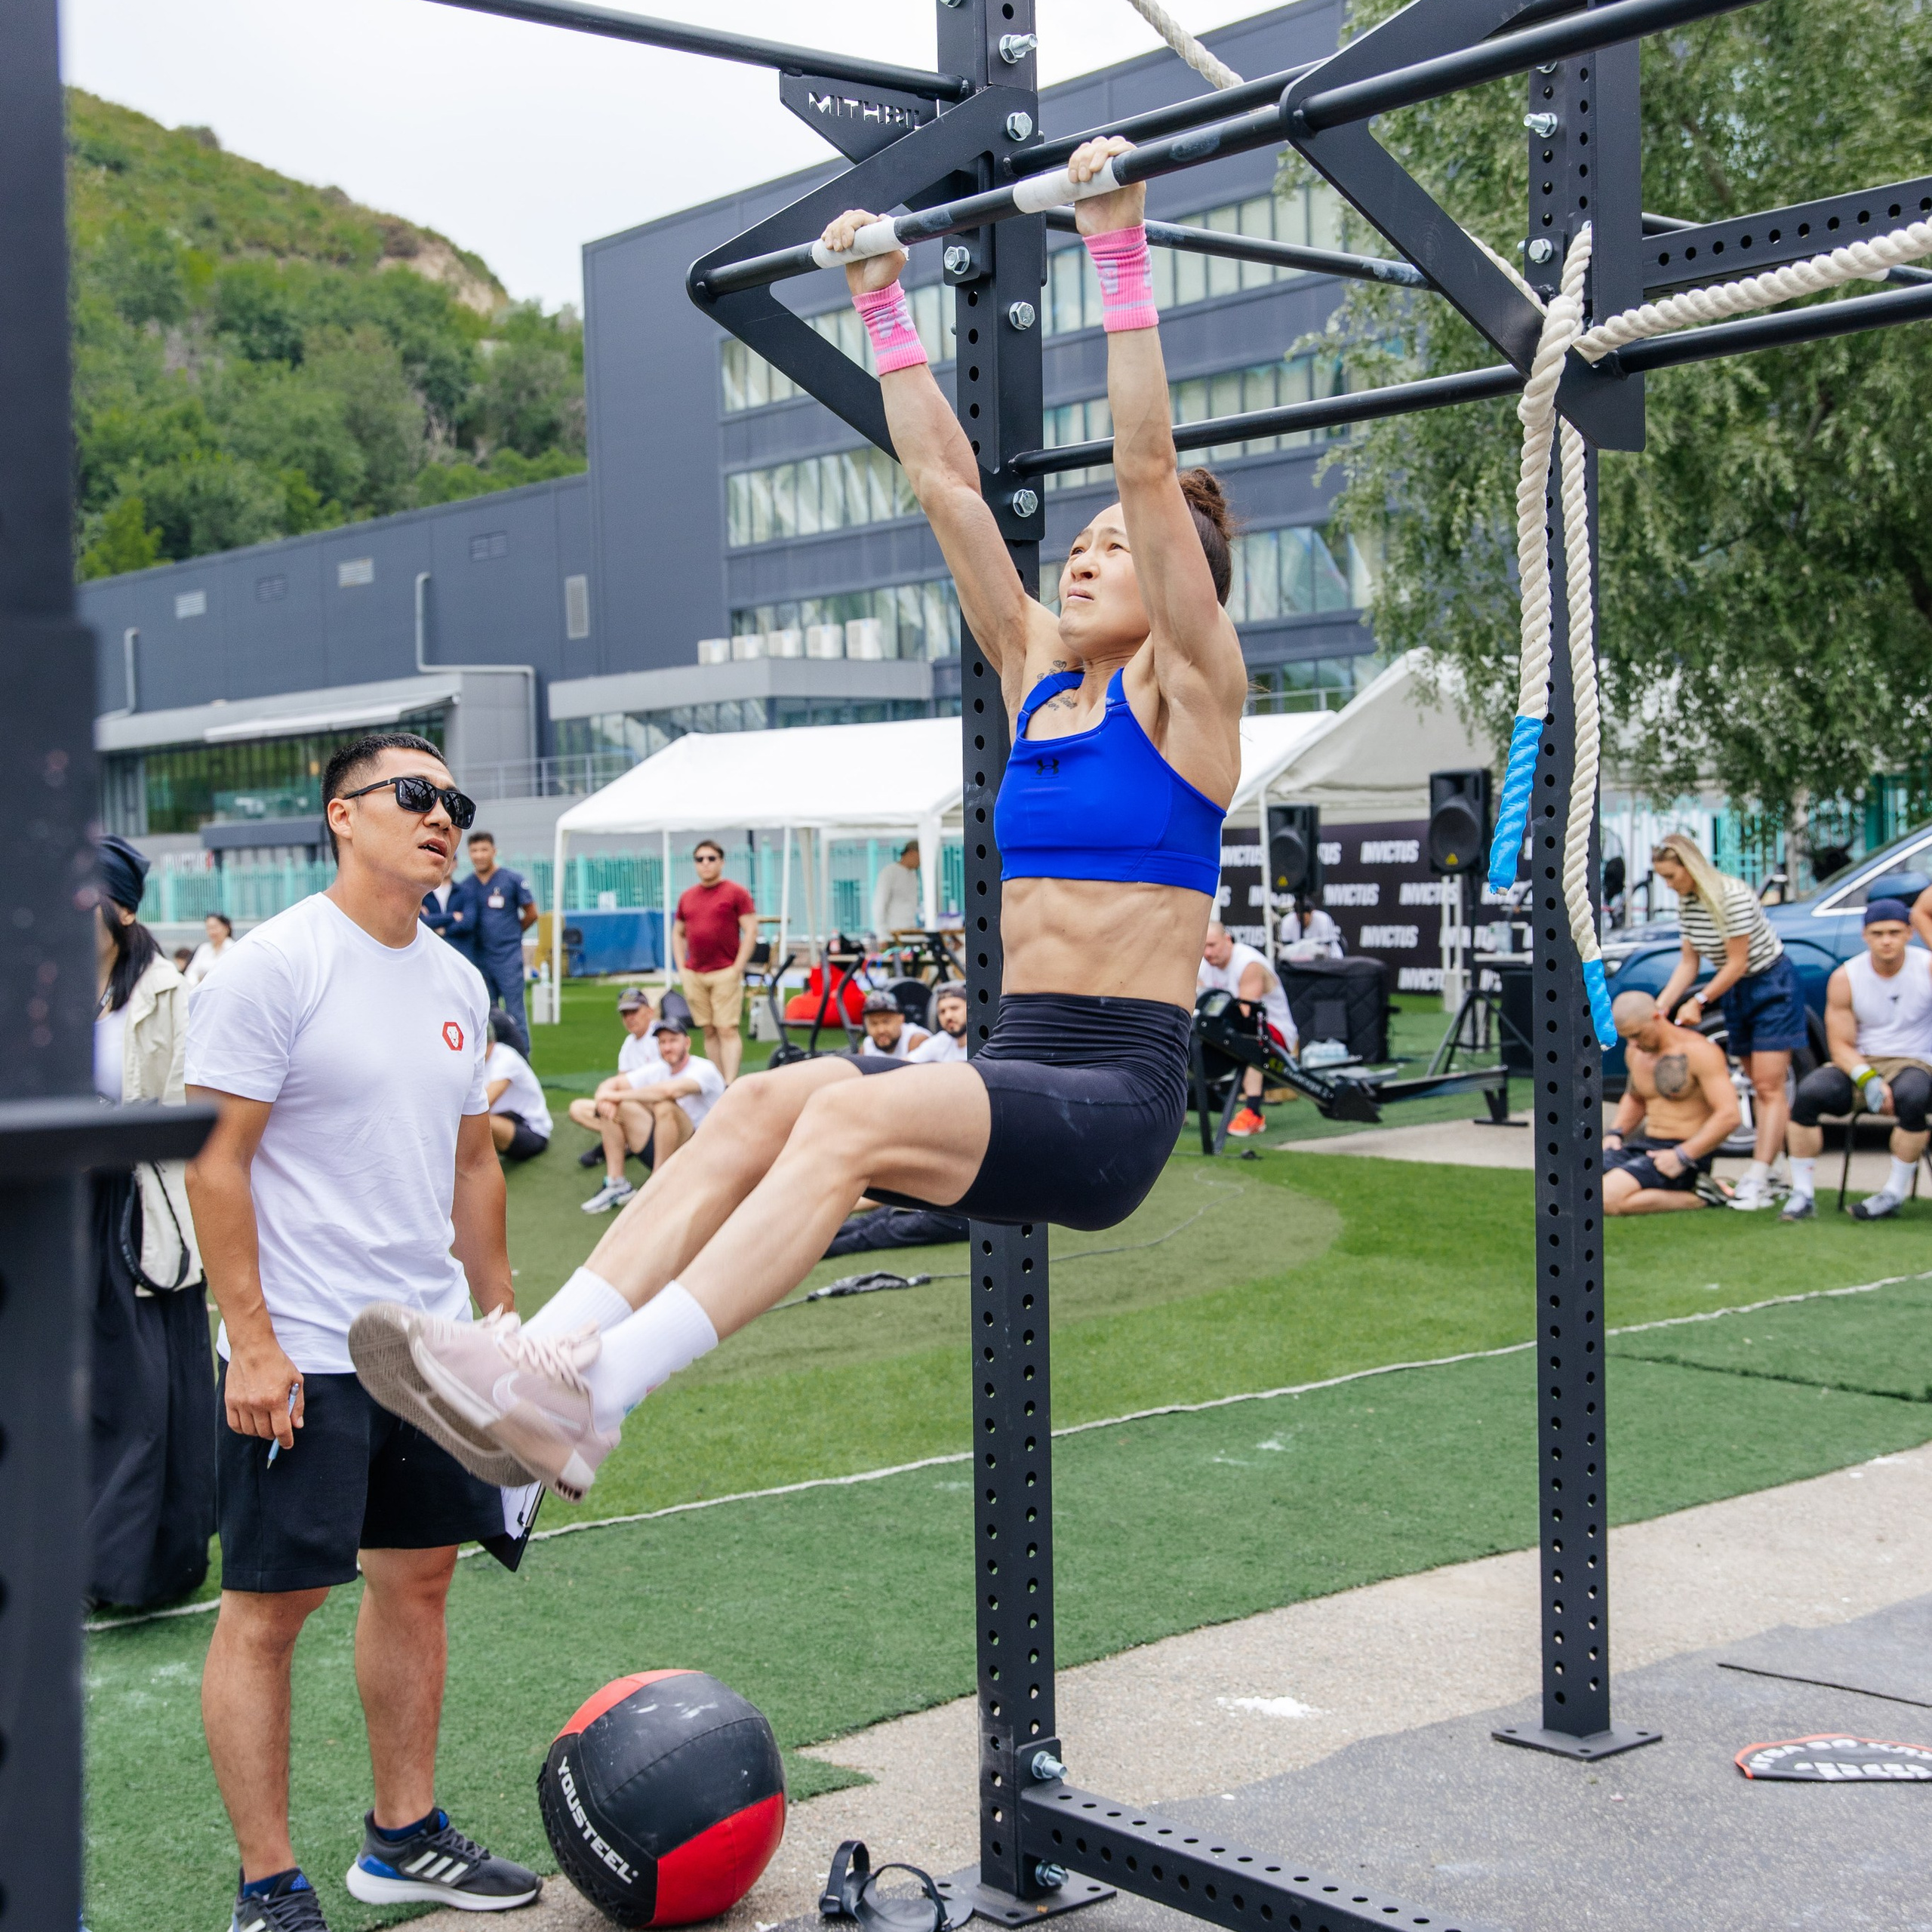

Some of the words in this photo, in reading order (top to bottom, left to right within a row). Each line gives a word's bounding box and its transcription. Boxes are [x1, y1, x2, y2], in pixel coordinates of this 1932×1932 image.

[1360, 840, 1420, 864] INVICTUS
[1323, 883, 1380, 906] INVICTUS
[1360, 925, 1419, 949] INVICTUS
[557, 1755, 633, 1884] YOUSTEEL
